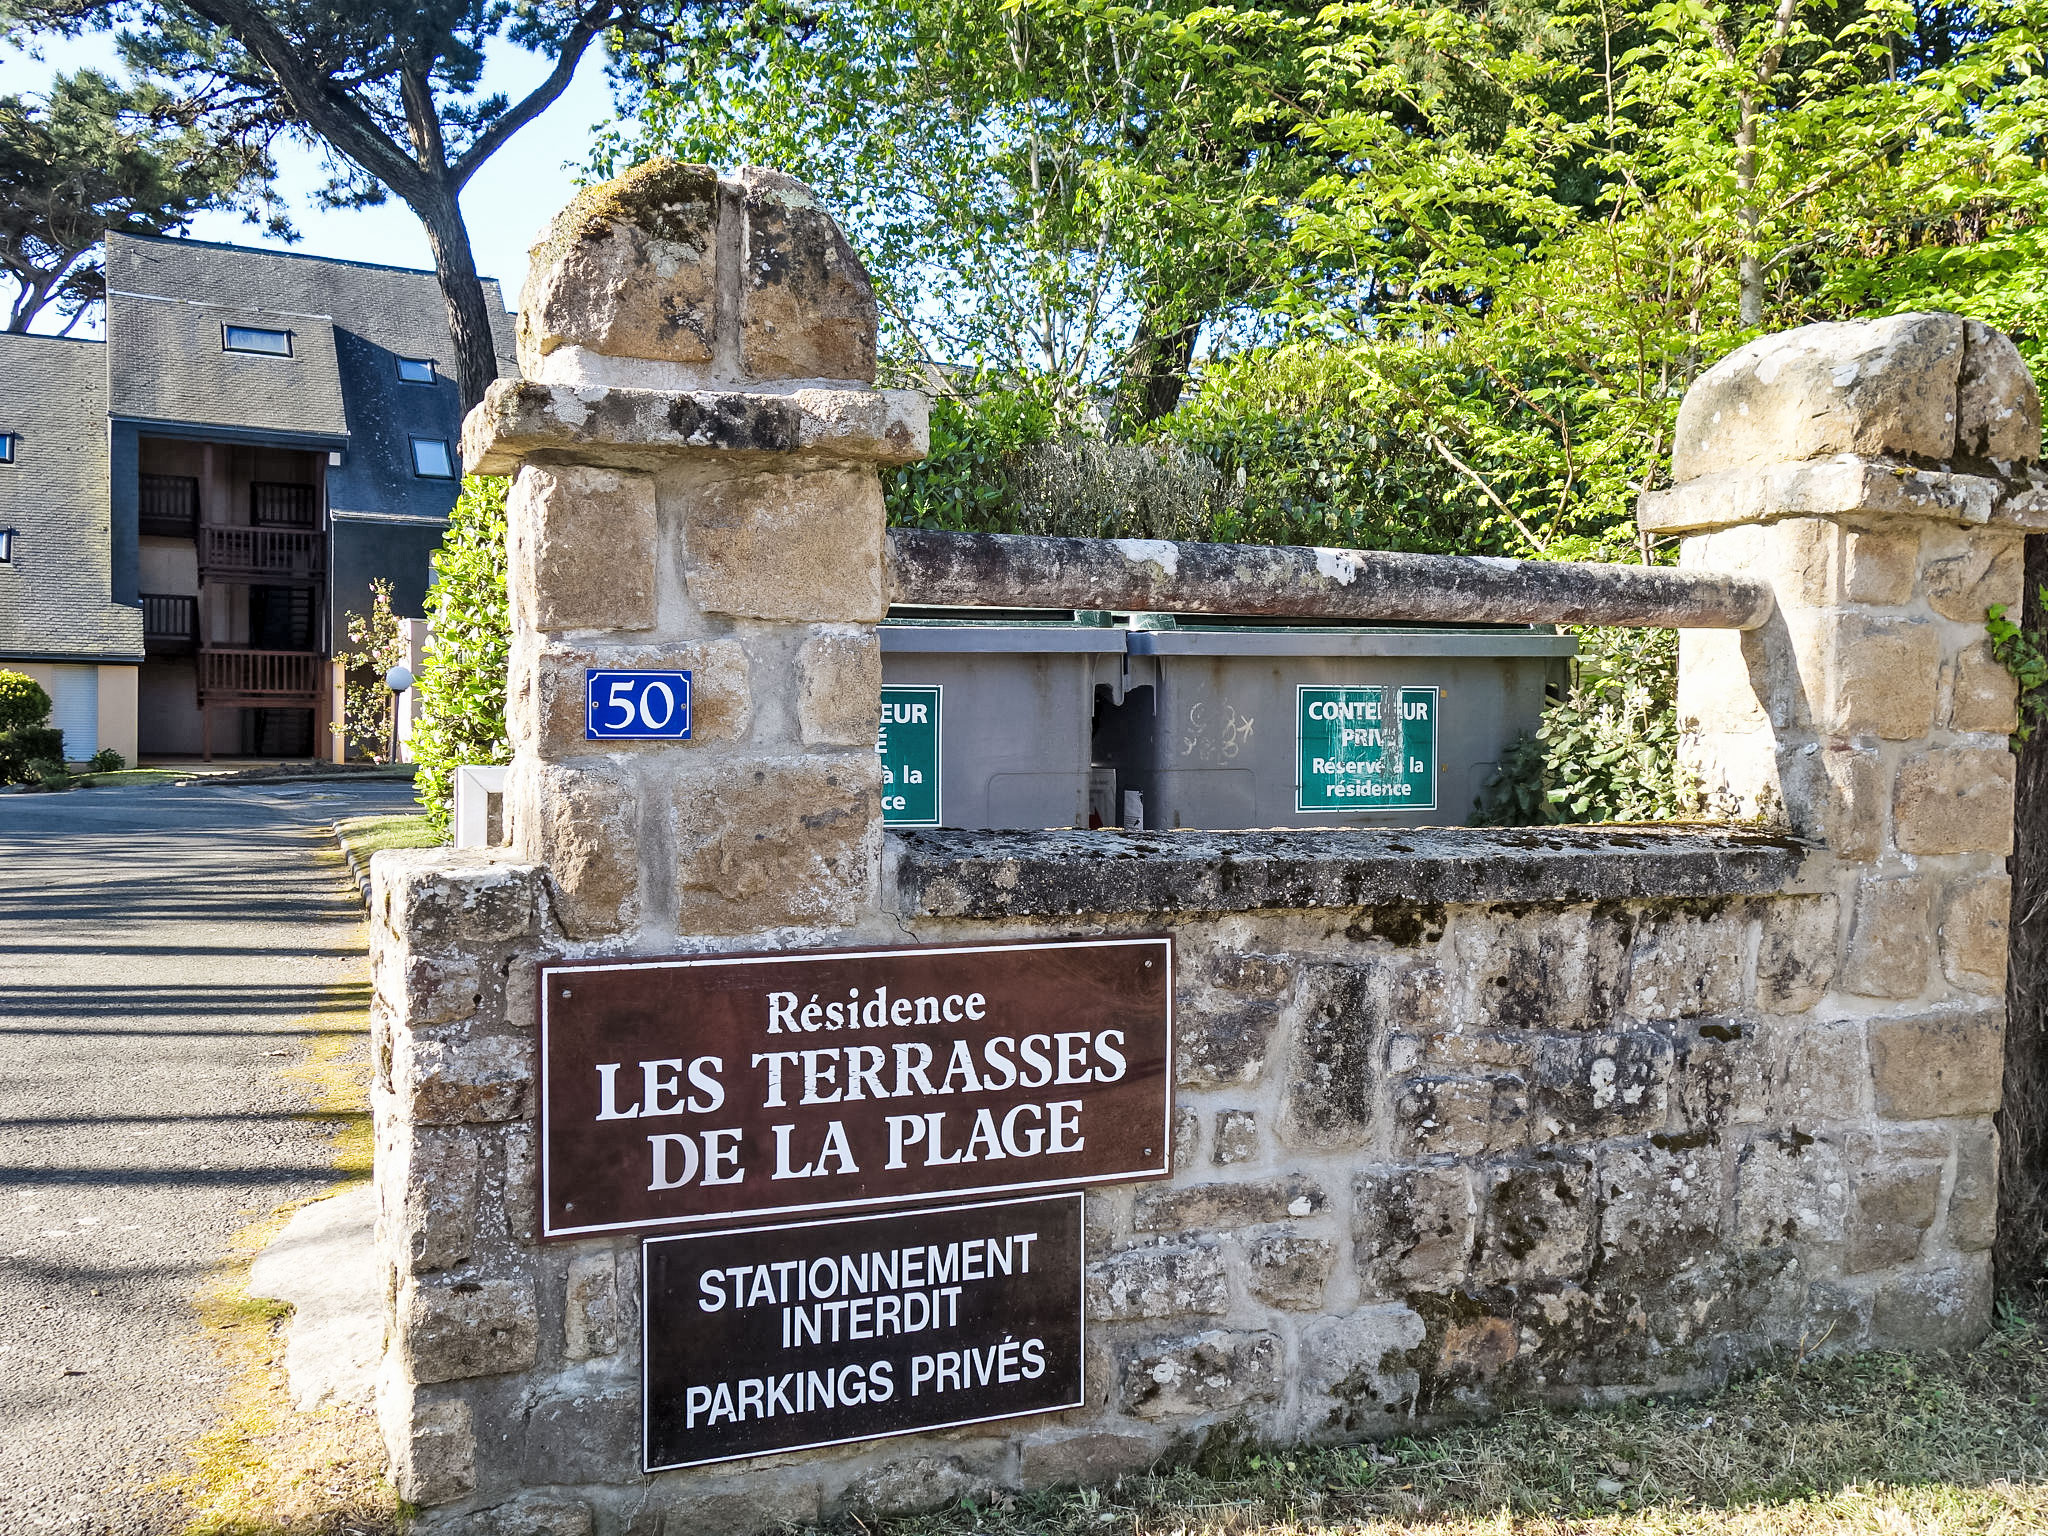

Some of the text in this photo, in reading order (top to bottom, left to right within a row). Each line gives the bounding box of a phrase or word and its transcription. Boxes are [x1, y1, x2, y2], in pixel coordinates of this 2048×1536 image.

[604, 680, 674, 729] 50
[1308, 702, 1428, 721] CONTEUR
[903, 765, 923, 784] la
[1326, 780, 1412, 797] résidence
[1409, 757, 1424, 773] la
[767, 986, 987, 1034] Résidence
[595, 1030, 1127, 1121] LES TERRASSES
[647, 1100, 1085, 1192] DE LA PLAGE
[698, 1233, 1037, 1313] STATIONNEMENT
[782, 1286, 962, 1348] INTERDIT
[686, 1336, 1046, 1429] PARKINGS PRIVÉS
